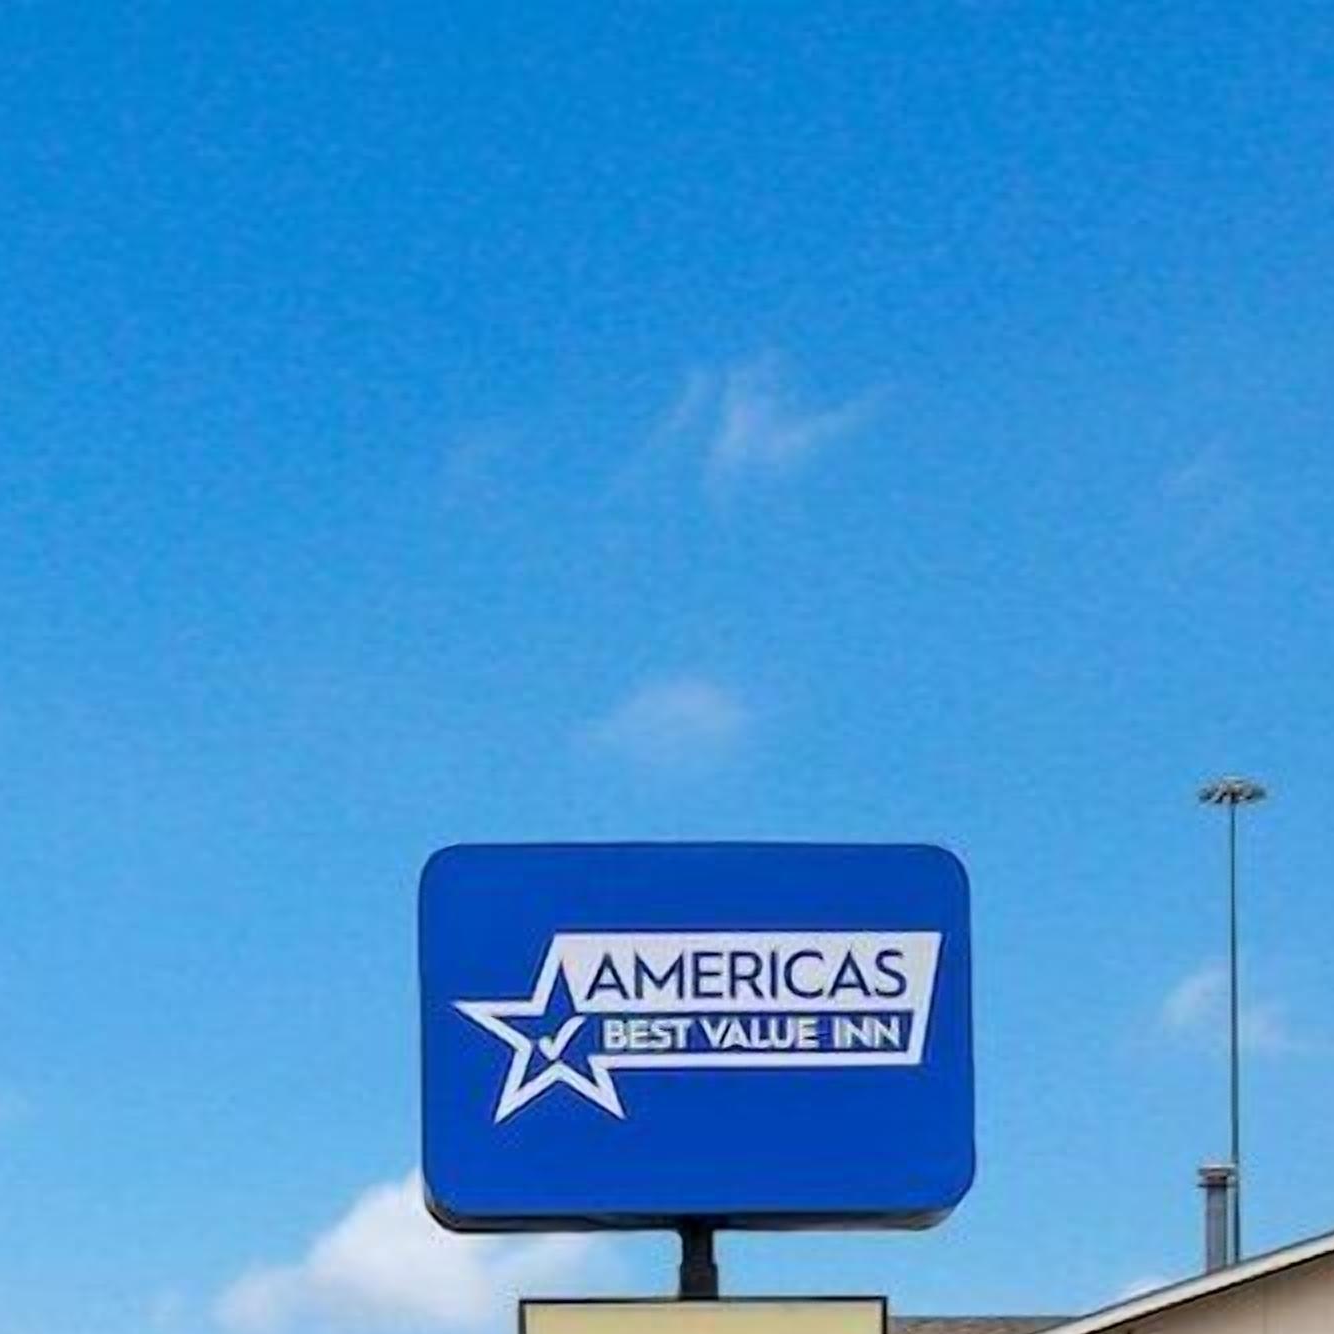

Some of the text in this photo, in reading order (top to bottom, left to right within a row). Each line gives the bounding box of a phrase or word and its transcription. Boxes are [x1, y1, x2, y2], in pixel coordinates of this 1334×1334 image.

[585, 950, 908, 1001] AMERICAS
[604, 1016, 901, 1051] BEST VALUE INN
